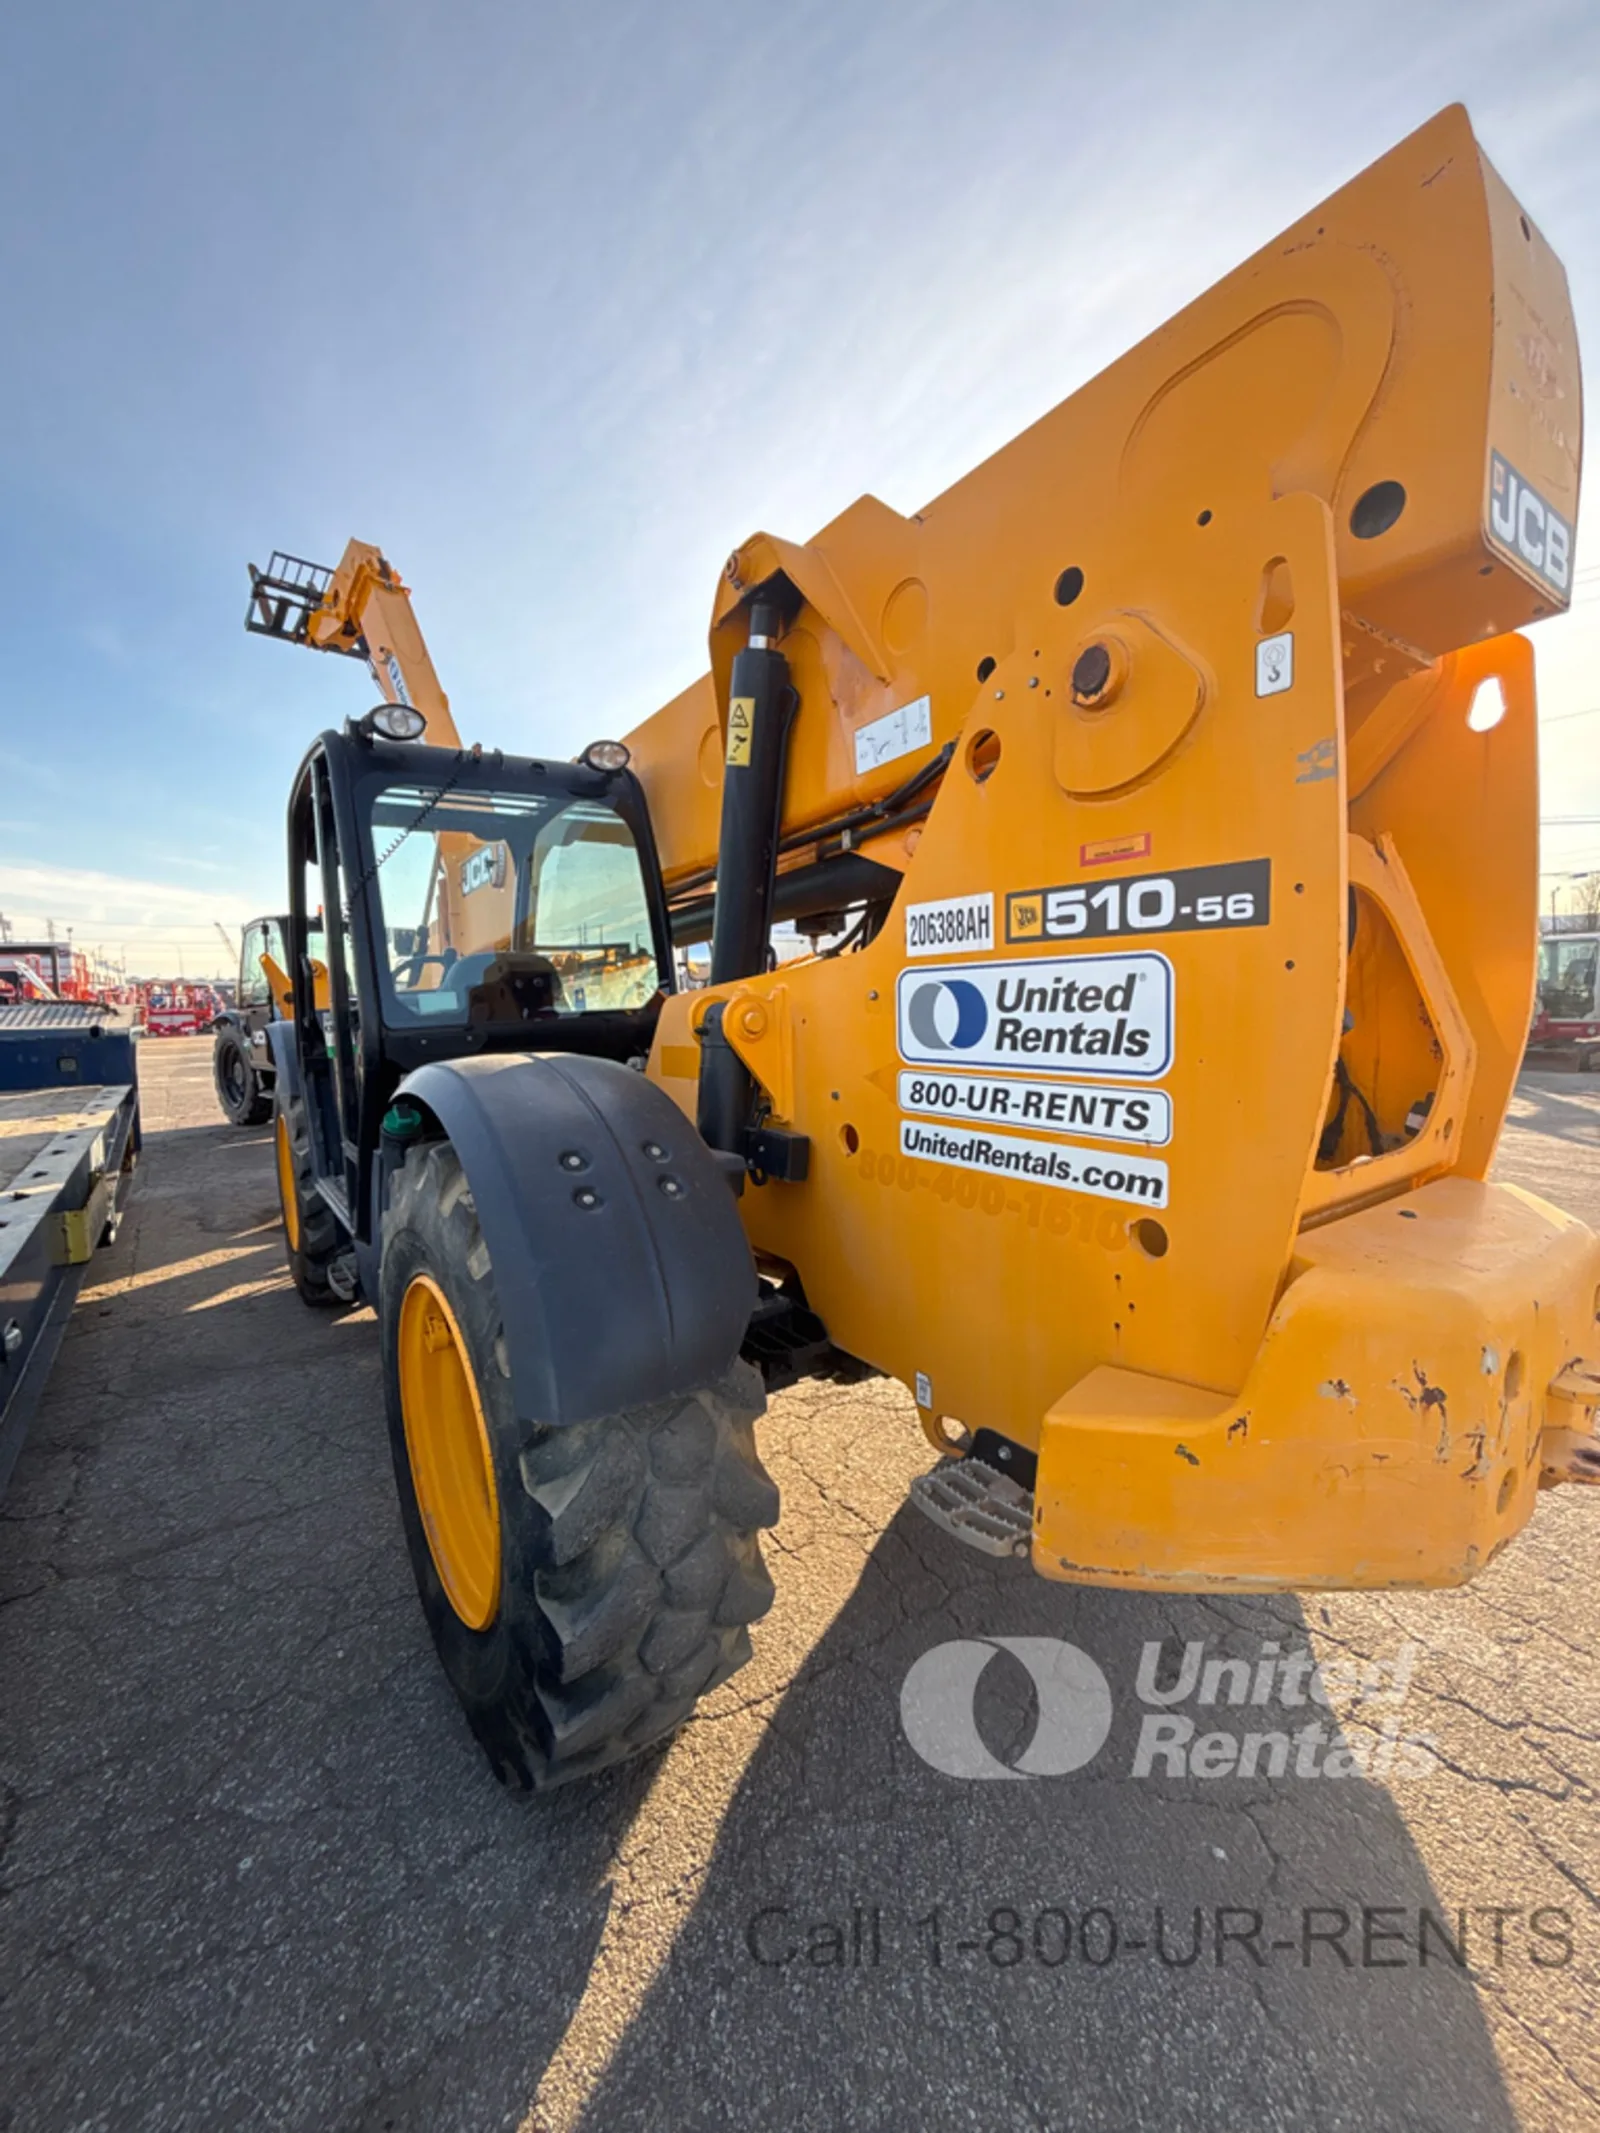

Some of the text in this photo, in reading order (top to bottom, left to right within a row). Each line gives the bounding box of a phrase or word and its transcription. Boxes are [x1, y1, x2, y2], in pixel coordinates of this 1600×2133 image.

[1491, 474, 1570, 589] JCB
[909, 904, 990, 947] 206388AH
[1046, 878, 1255, 935] 510-56
[995, 972, 1138, 1014] United
[995, 1018, 1150, 1058] Rentals
[909, 1080, 1150, 1133] 800-UR-RENTS
[903, 1128, 1163, 1199] UnitedRentals.com
